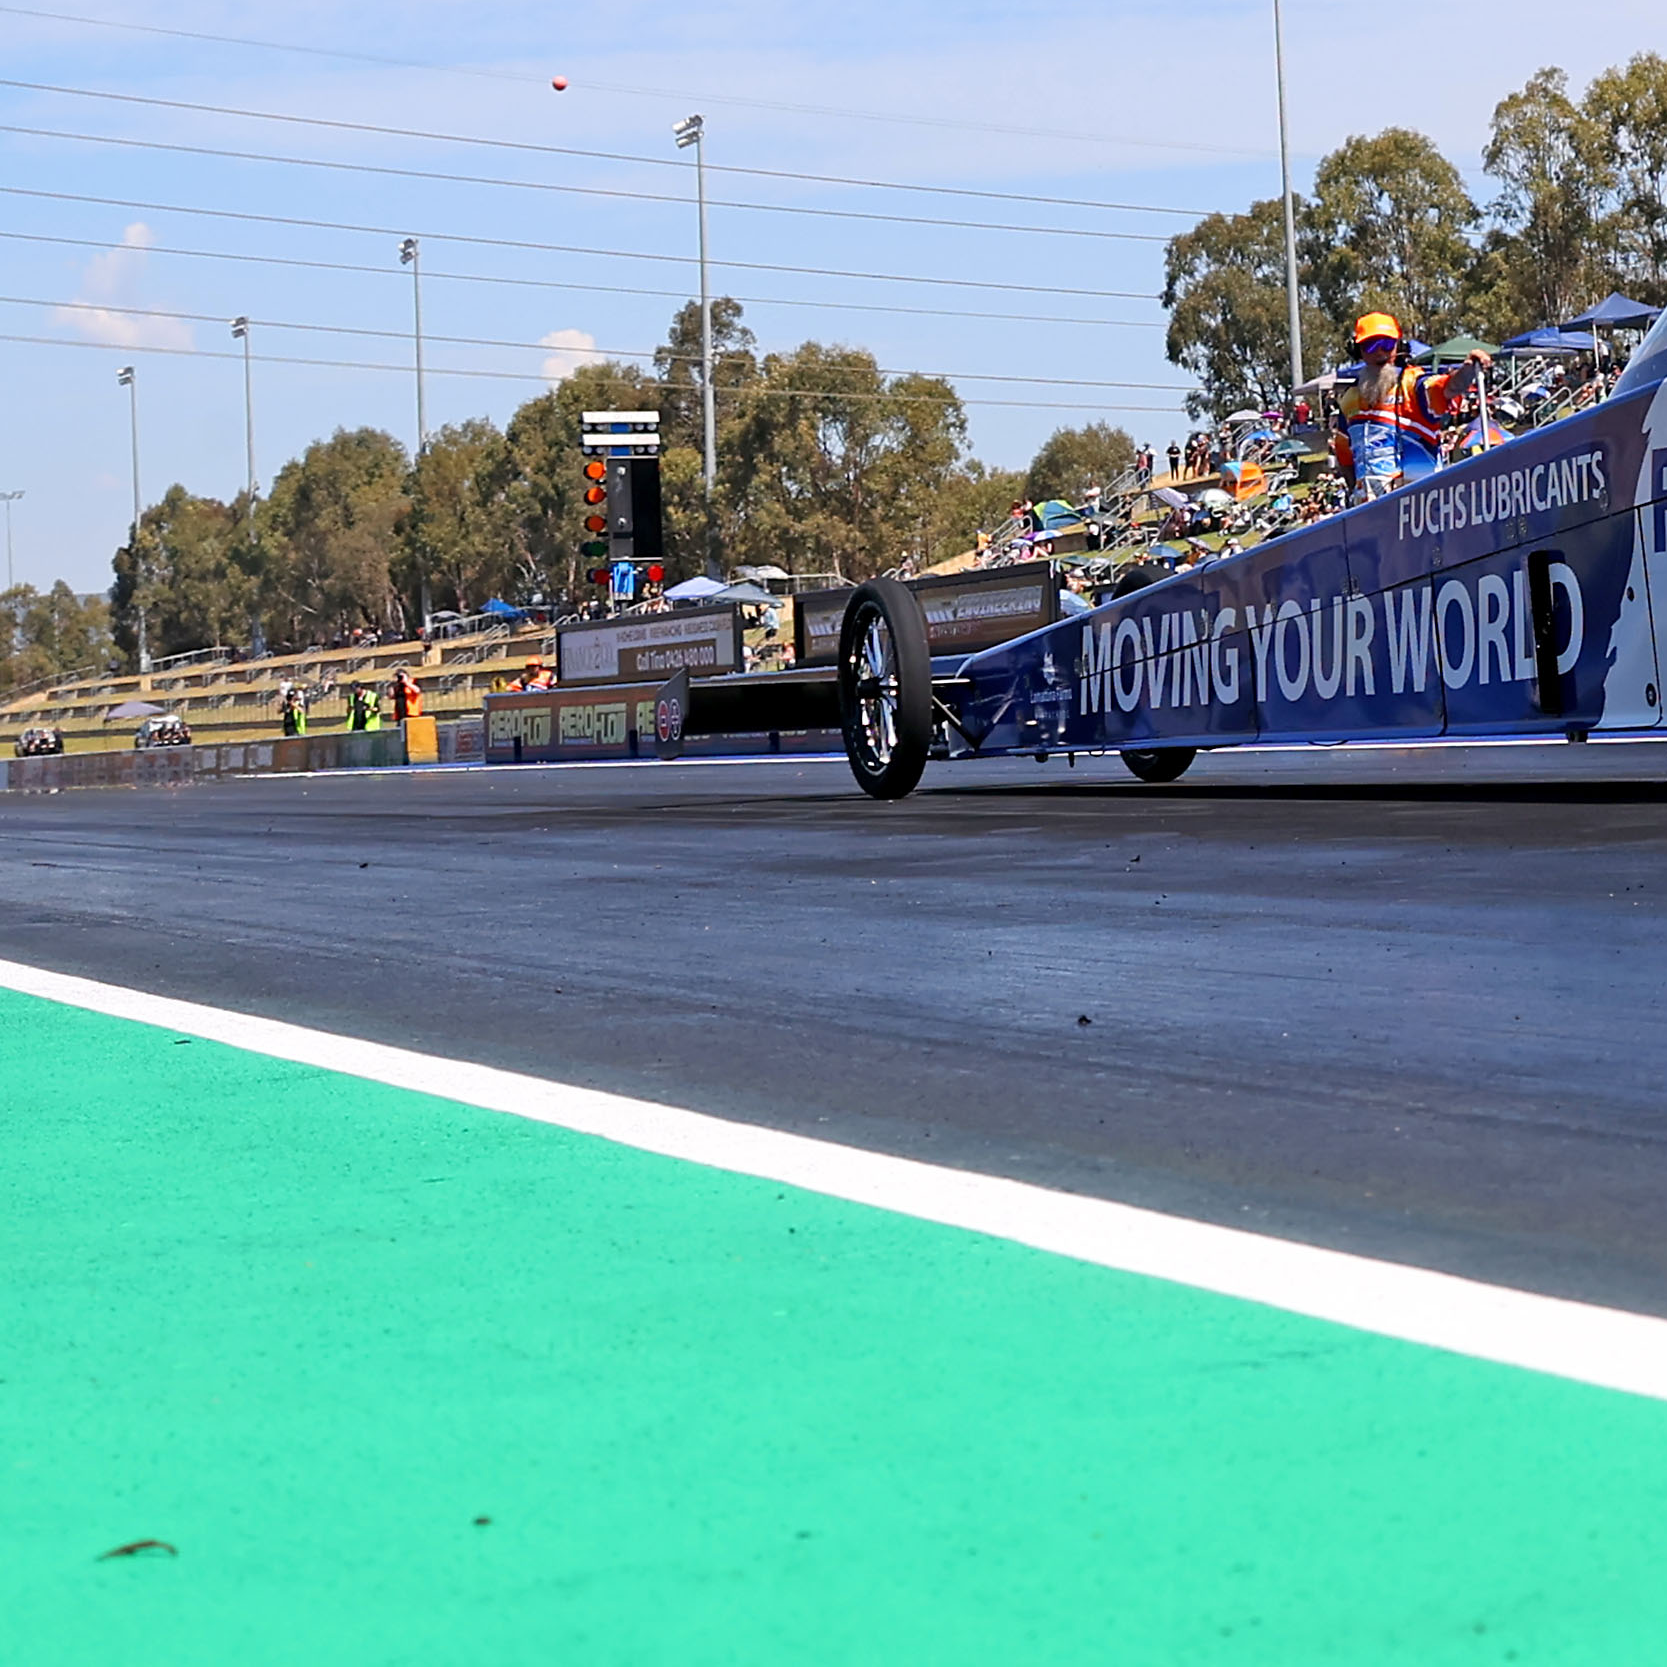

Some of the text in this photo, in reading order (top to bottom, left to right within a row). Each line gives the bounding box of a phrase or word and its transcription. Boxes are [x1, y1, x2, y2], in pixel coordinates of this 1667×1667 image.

[1399, 450, 1605, 540] FUCHS LUBRICANTS
[1080, 562, 1584, 716] MOVING YOUR WORLD
